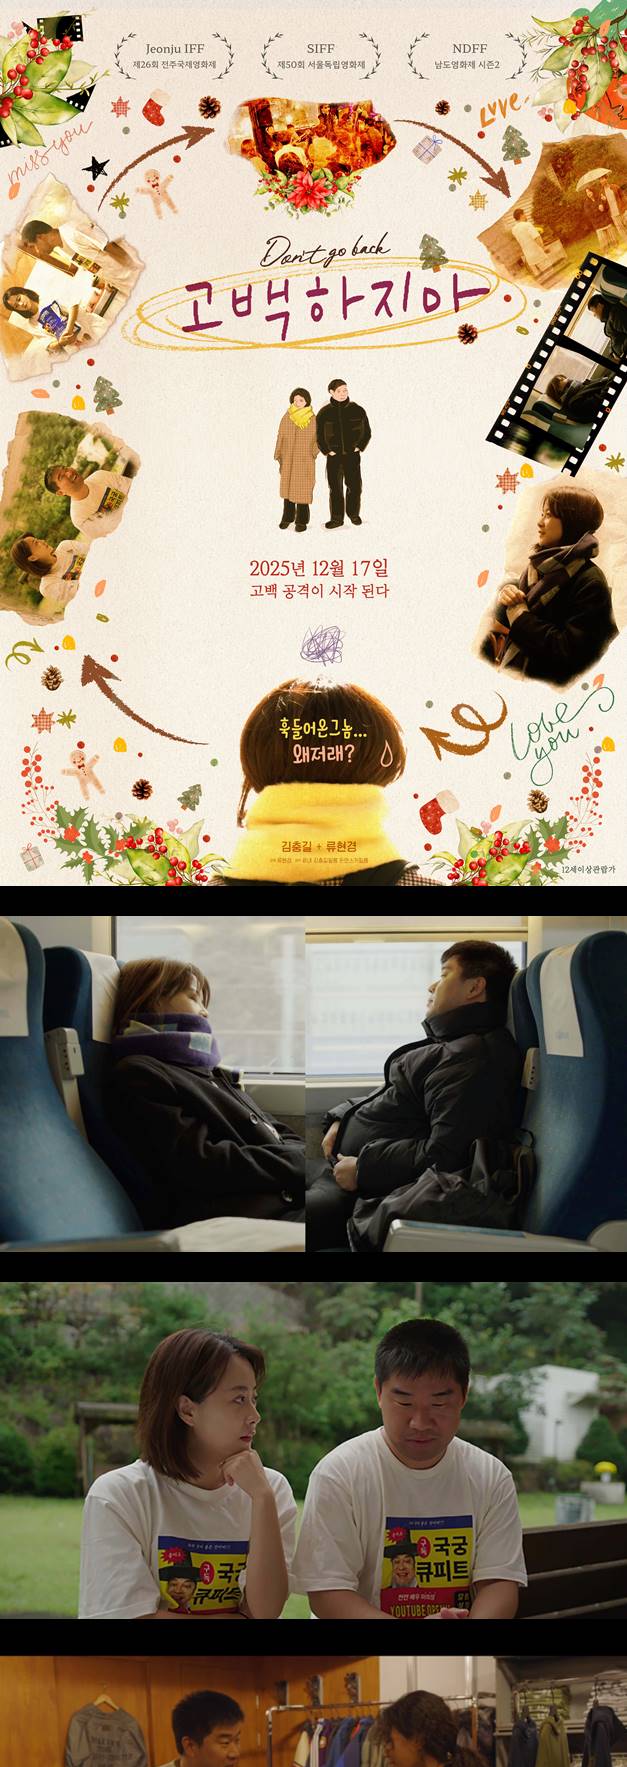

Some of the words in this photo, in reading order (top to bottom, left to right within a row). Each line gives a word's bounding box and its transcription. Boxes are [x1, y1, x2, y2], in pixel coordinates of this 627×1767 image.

[146, 43, 181, 56] Jeonju
[184, 43, 205, 54] IFF
[307, 43, 335, 54] SIFF
[452, 43, 488, 54] NDFF
[132, 60, 160, 69] 제26회
[161, 60, 217, 69] 전주국제영화제
[277, 60, 305, 69] 제50회
[307, 60, 366, 70] 서울독립영화제
[434, 60, 476, 70] 남도영화제
[478, 60, 500, 69] 시즌2
[52, 121, 93, 156] you
[328, 246, 347, 265] go
[351, 232, 392, 256] back
[249, 559, 305, 577] 2025년
[312, 559, 345, 577] 12월
[352, 558, 389, 577] 17일
[249, 583, 277, 599] 고백
[282, 583, 323, 599] 공격이
[328, 583, 358, 599] 시작
[361, 583, 390, 599] 된다
[292, 743, 355, 764] 왜저래?
[530, 728, 580, 787] you
[281, 840, 312, 853] 김충길
[325, 840, 357, 853] 류현경
[561, 865, 616, 875] 12세이상관람가
[433, 1535, 468, 1557] 국궁
[416, 1559, 469, 1583] 큐피트
[391, 1603, 426, 1618] YOUTUBE
